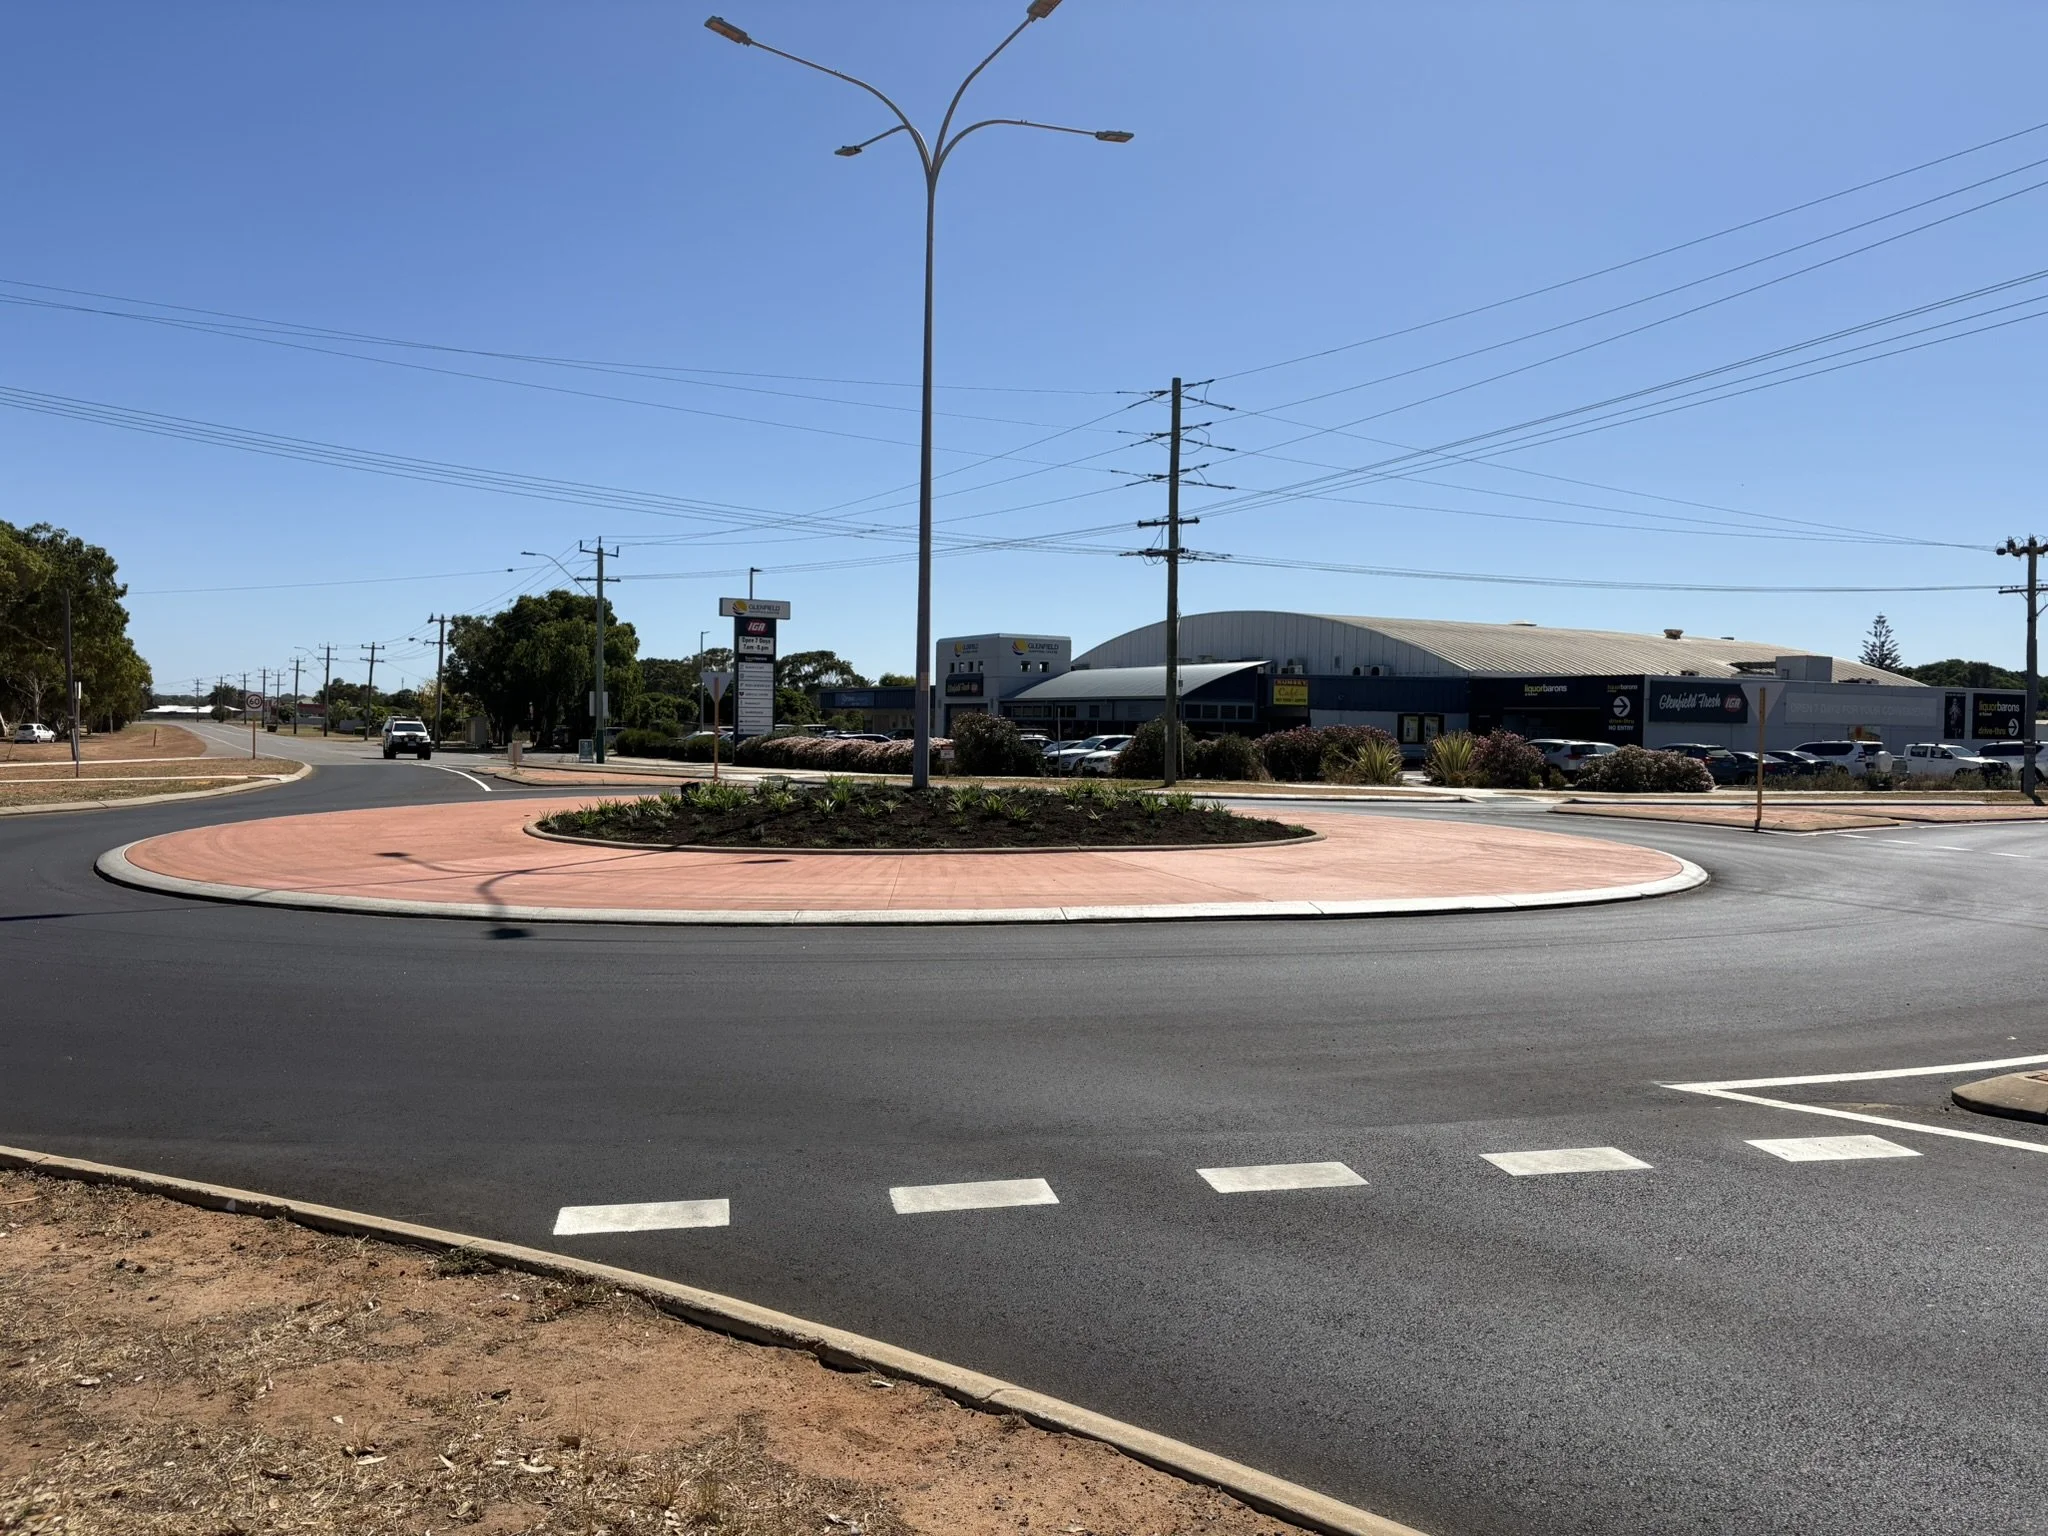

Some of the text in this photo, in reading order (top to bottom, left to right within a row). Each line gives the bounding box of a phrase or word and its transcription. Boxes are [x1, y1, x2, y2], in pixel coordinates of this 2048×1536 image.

[748, 622, 767, 632] IGA
[1524, 684, 1568, 694] liquorbarons
[1659, 692, 1722, 712] Glenfield Fresh
[1725, 697, 1742, 709] IGA
[1979, 700, 2020, 713] liquorbarons
